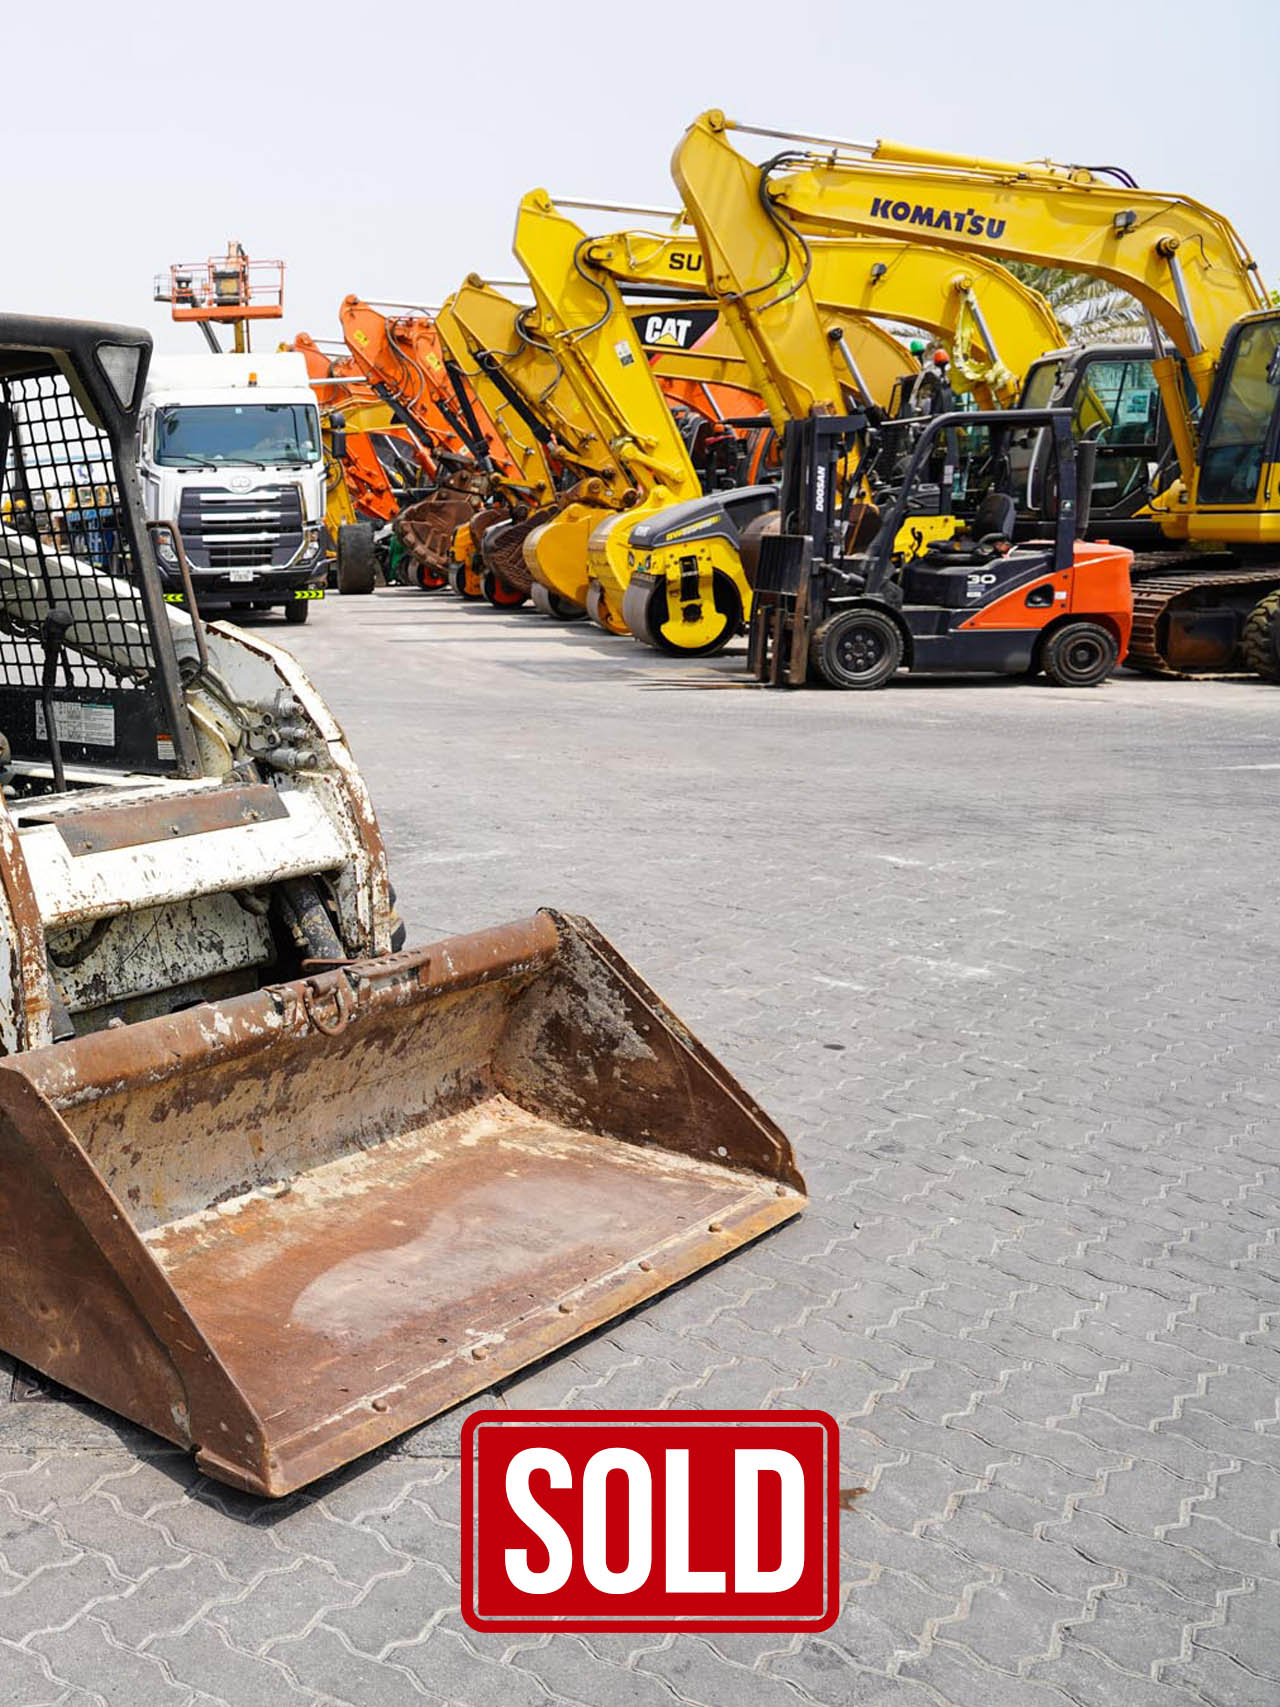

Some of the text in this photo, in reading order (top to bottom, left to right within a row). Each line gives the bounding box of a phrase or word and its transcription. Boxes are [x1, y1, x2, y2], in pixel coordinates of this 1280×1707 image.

[869, 197, 1006, 240] KOMATSU
[644, 315, 692, 347] CAT
[966, 573, 997, 585] 30
